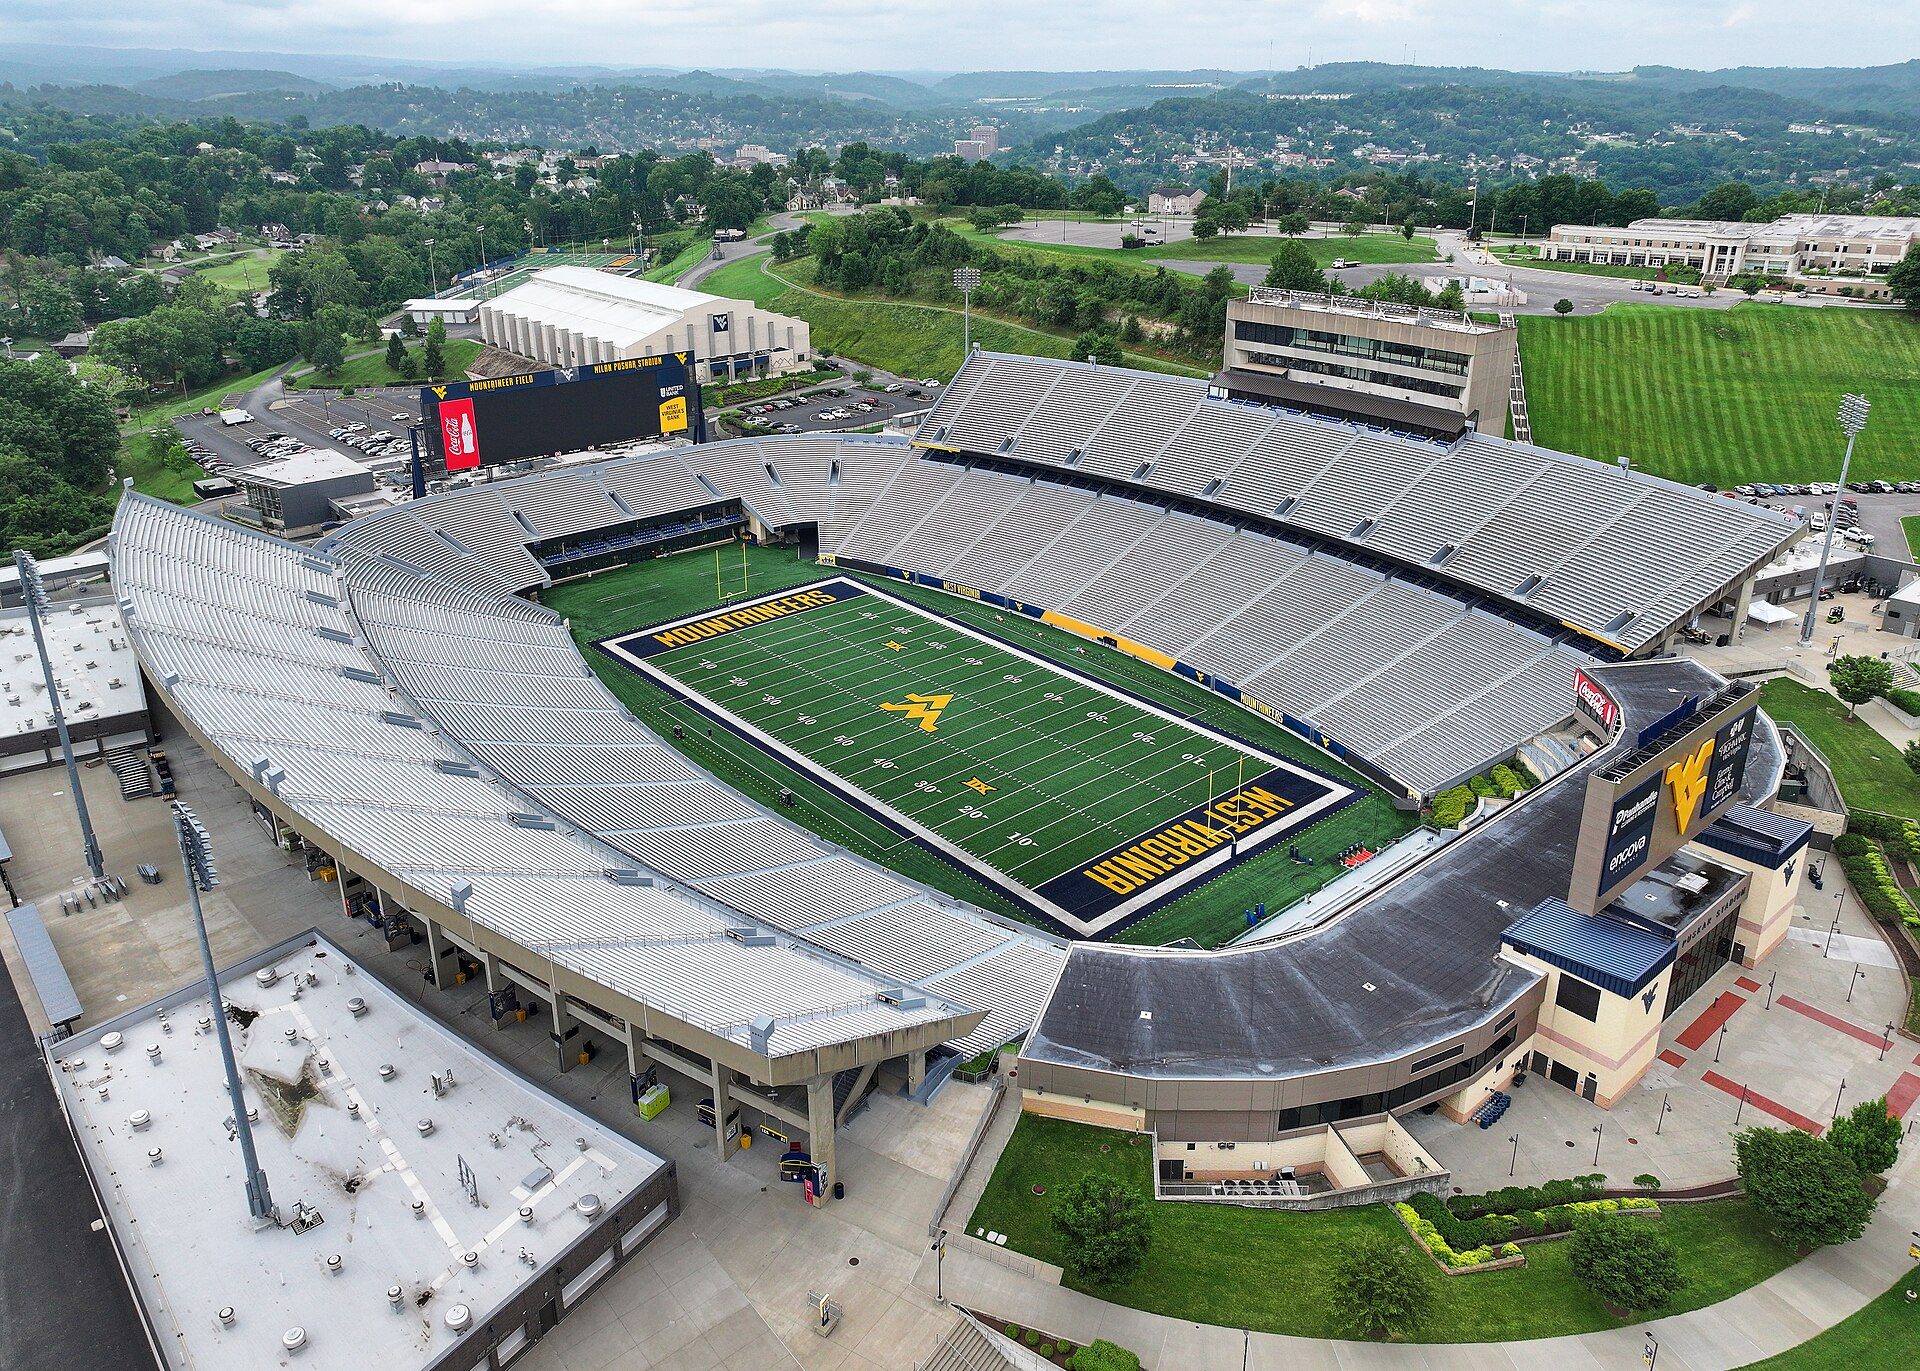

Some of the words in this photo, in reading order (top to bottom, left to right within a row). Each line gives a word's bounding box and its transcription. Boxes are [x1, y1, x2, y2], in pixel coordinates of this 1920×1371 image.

[594, 365, 612, 374] MILAN
[613, 360, 636, 371] PUSKAR
[637, 356, 662, 367] STADIUM
[469, 378, 513, 391] MOUNTAINEER
[515, 374, 534, 385] FIELD
[666, 384, 684, 392] UNITED
[662, 408, 684, 417] VIRGINIA'S
[943, 580, 957, 590] WEST
[957, 584, 981, 599] VIRGINIA
[652, 589, 837, 648] MOUNTAINEERS
[1240, 692, 1283, 723] MOUNTAINEERS
[833, 735, 854, 746] 50
[914, 780, 938, 793] 30
[958, 805, 983, 818] 20
[1203, 786, 1294, 834] WEST
[1006, 831, 1033, 846] 10
[1083, 819, 1232, 895] VIRGINIA
[1609, 835, 1646, 871] encova
[1681, 917, 1712, 948] PUSKAR
[1715, 886, 1747, 918] STADIUM
